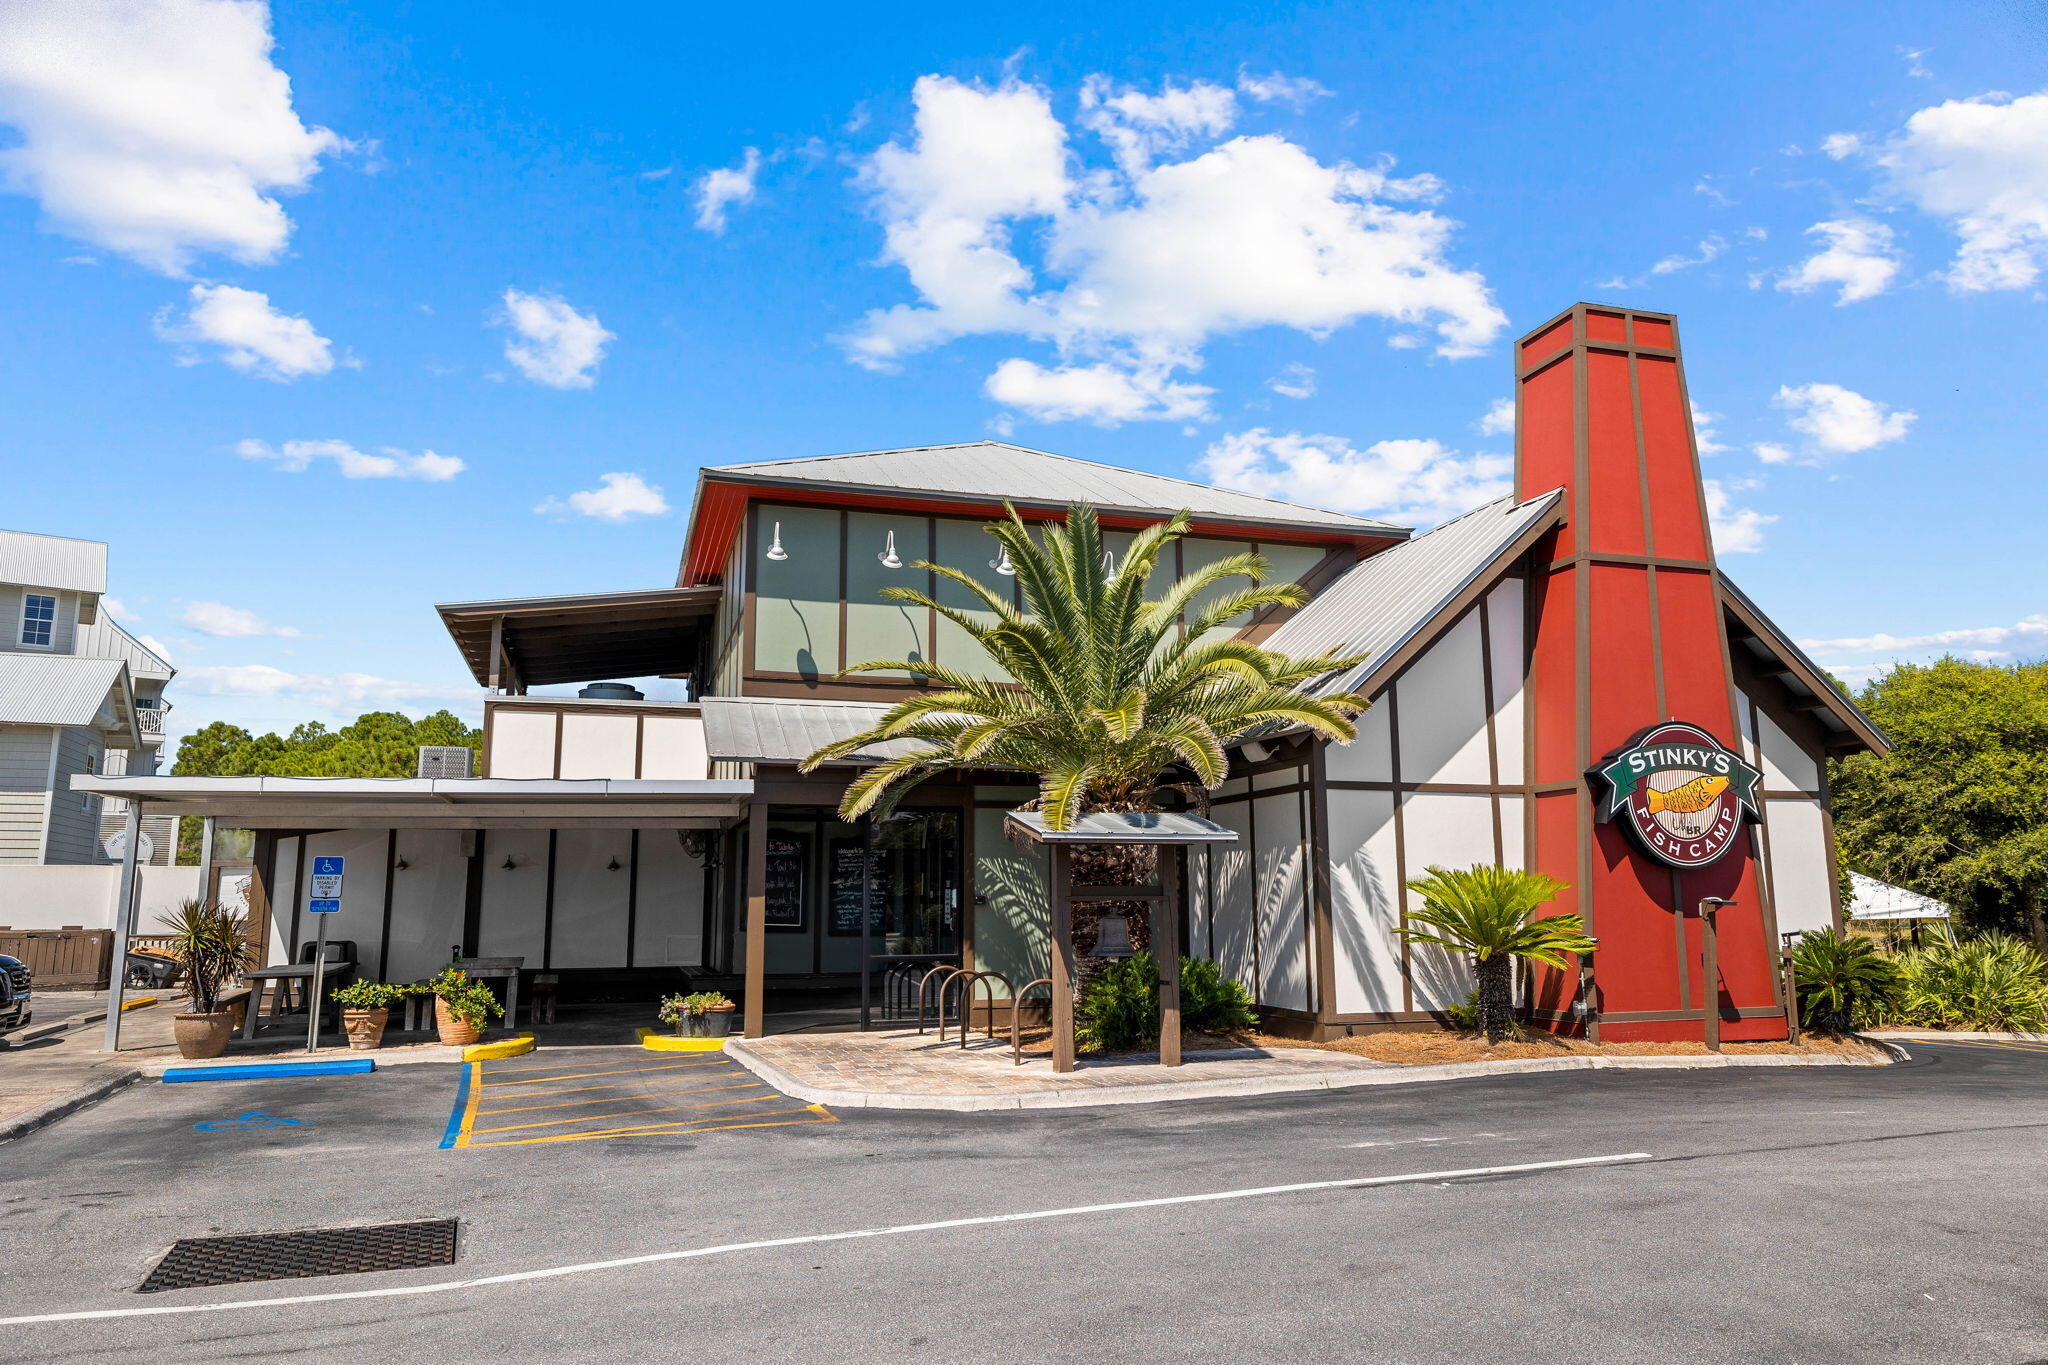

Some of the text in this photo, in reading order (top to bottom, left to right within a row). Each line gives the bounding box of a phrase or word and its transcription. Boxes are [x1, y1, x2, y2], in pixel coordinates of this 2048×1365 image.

[1628, 748, 1731, 774] STINKY'S
[1637, 807, 1732, 857] FISH CAMP
